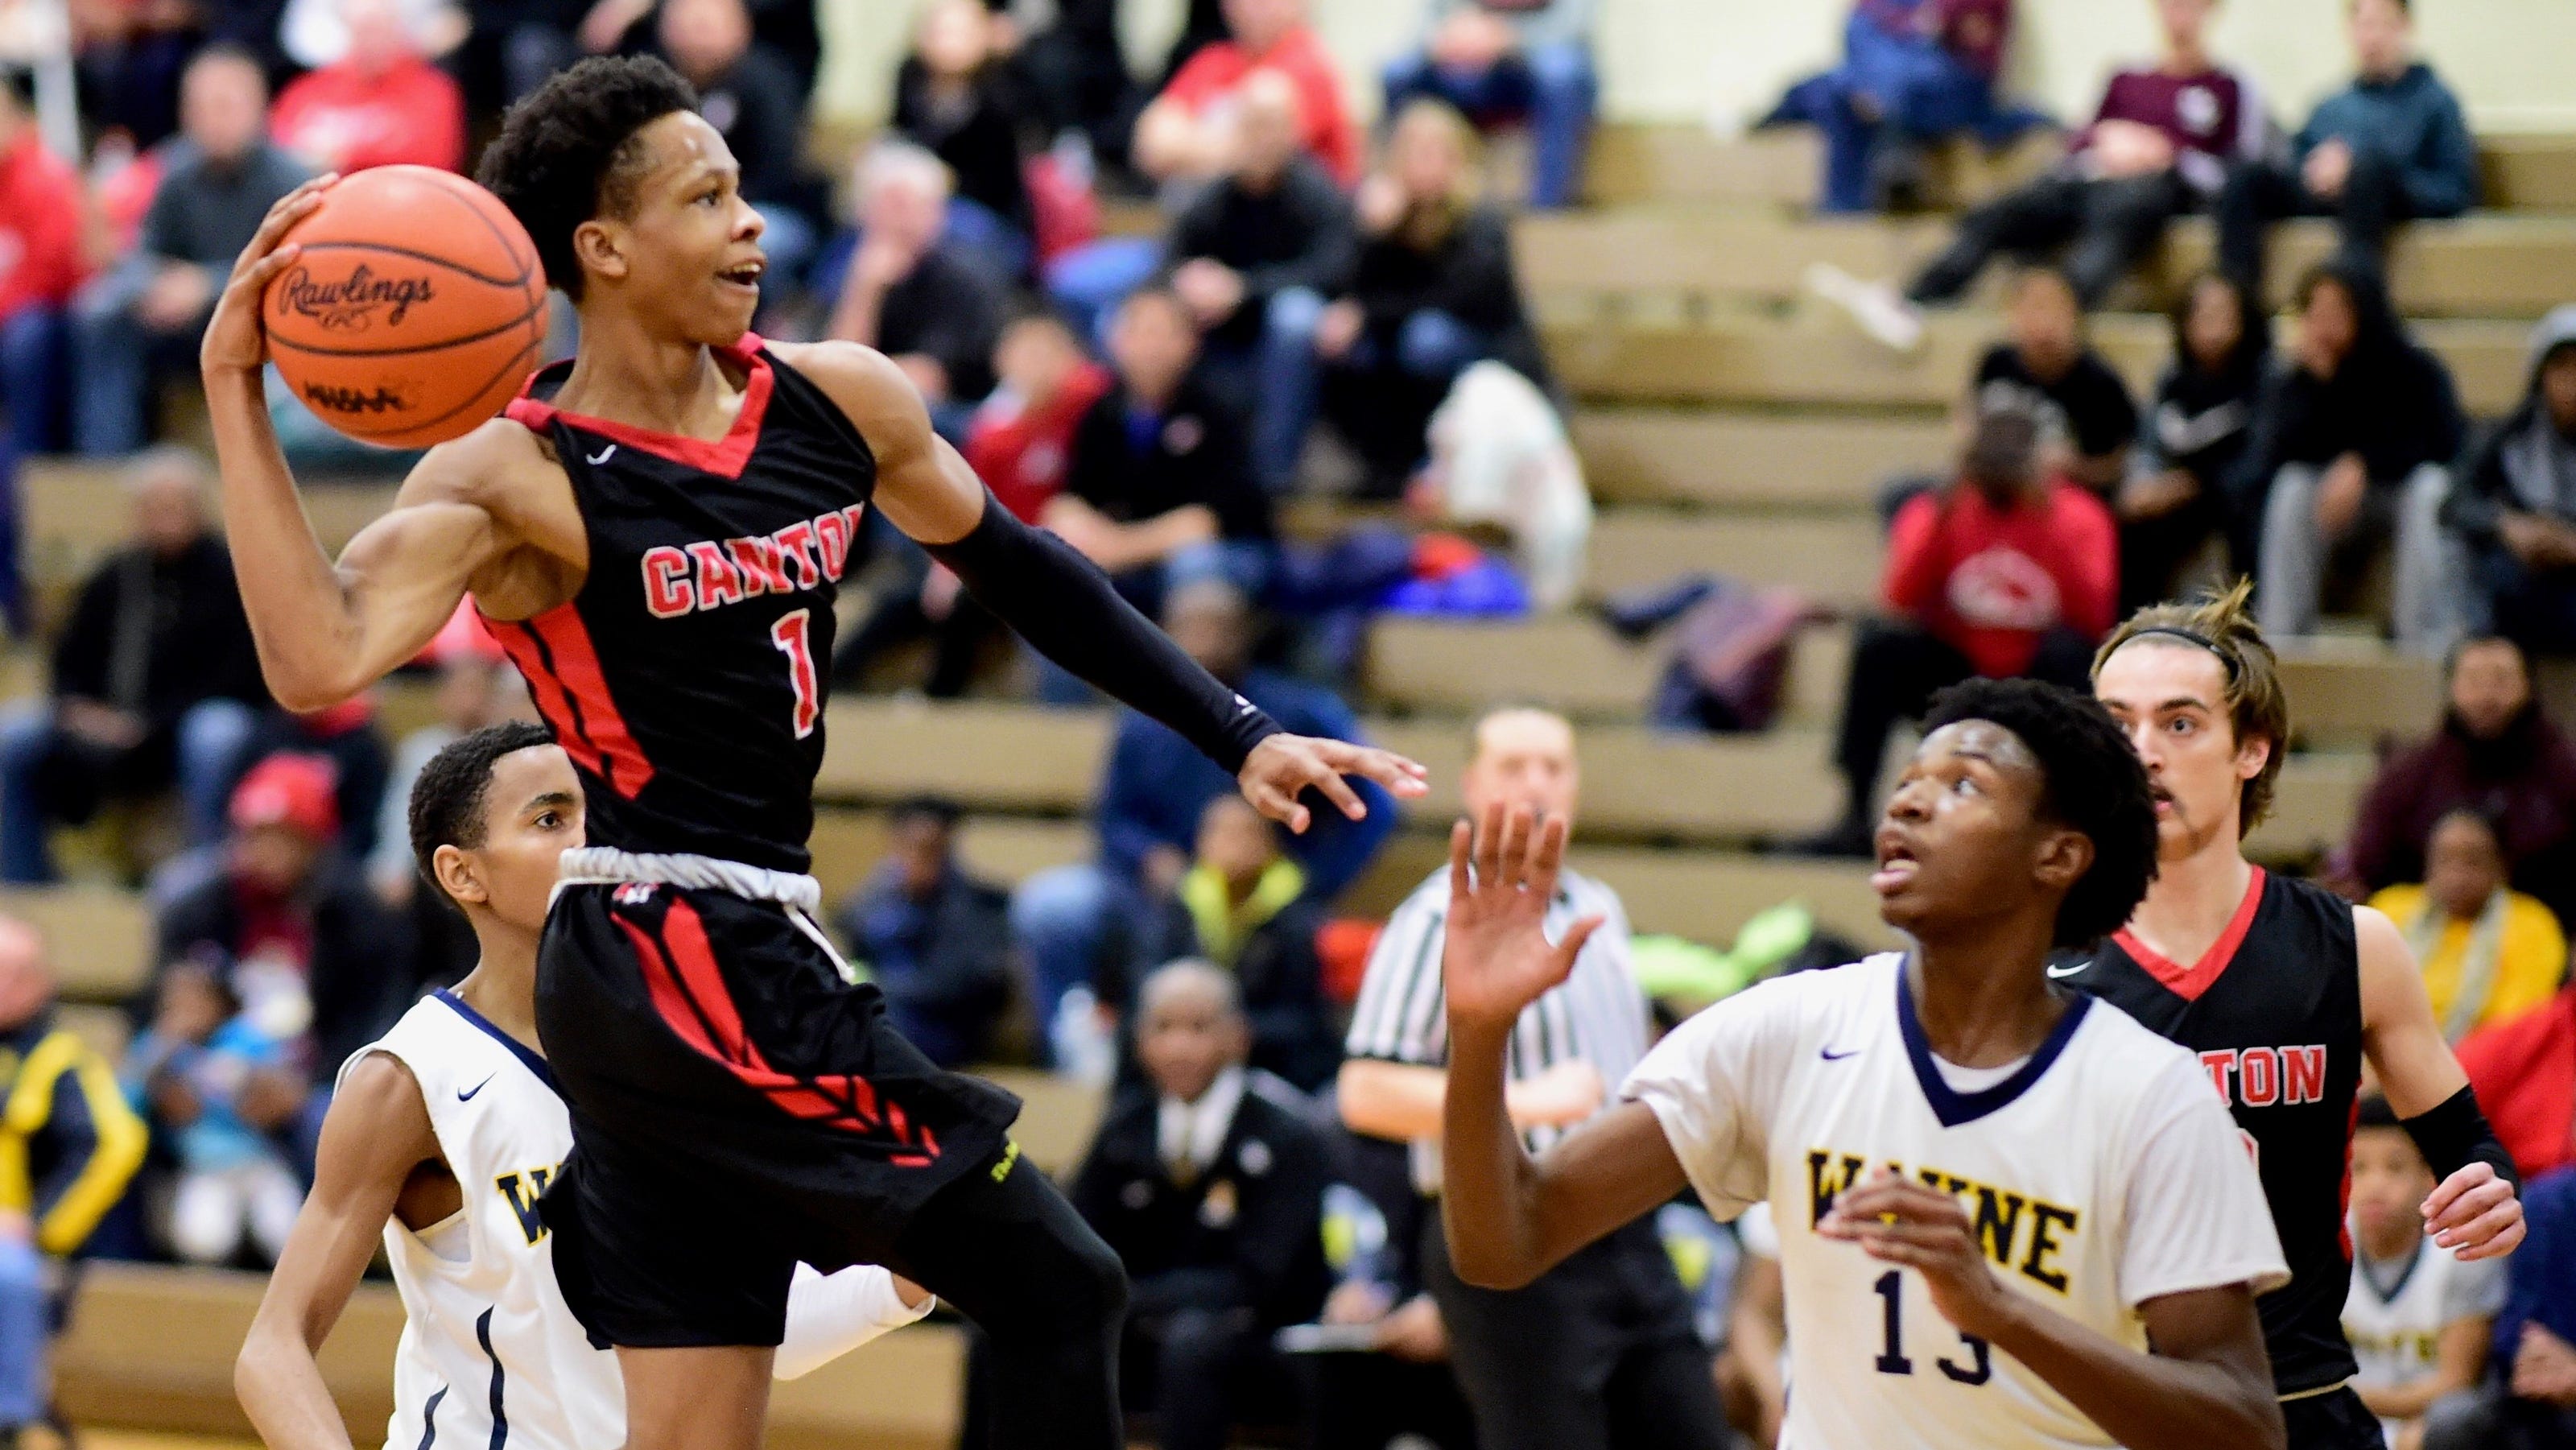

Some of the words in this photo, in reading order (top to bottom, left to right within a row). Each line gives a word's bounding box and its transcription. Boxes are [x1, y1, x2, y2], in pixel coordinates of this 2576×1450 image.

[279, 264, 435, 327] Rawlings
[770, 607, 819, 740] 1
[2198, 1044, 2327, 1108] TON
[1806, 1150, 2081, 1297] WNE
